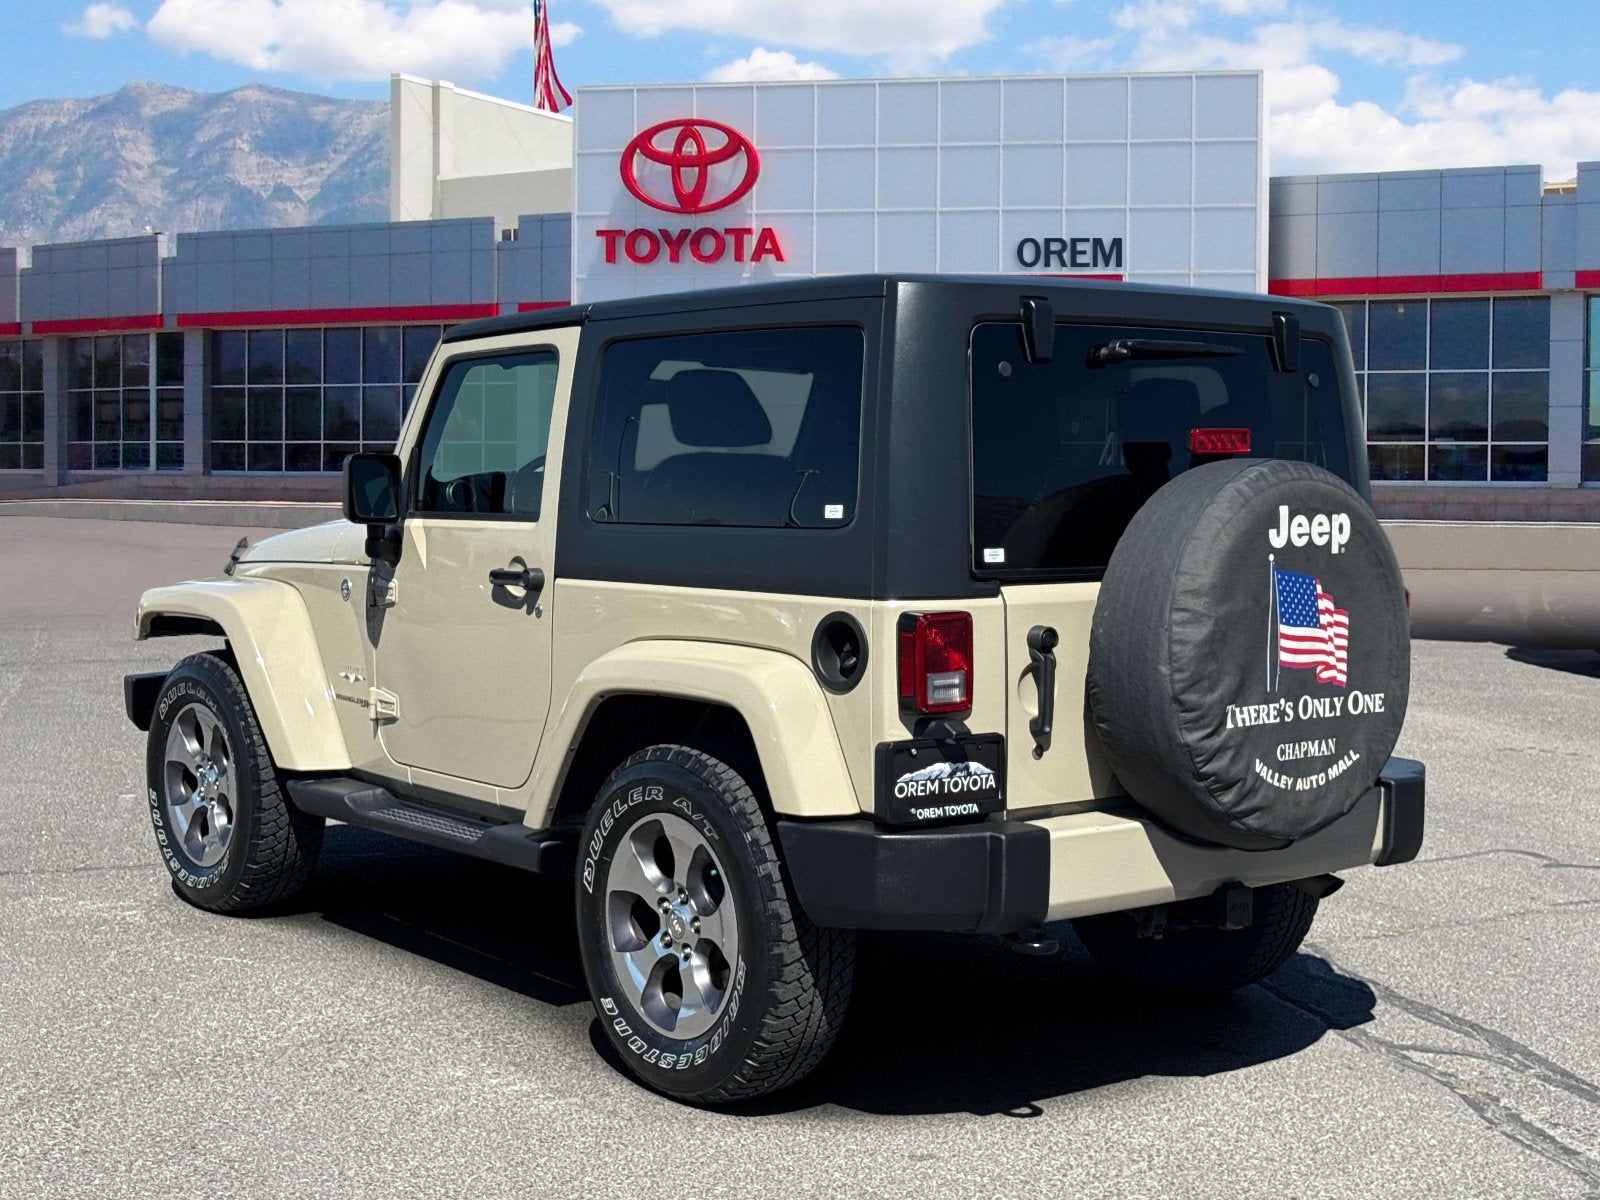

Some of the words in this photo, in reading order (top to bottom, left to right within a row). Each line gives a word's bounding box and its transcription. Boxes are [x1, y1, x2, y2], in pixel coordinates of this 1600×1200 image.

[595, 227, 785, 264] TOYOTA
[1016, 237, 1123, 268] OREM
[1268, 505, 1351, 554] Jeep
[1225, 697, 1294, 729] THERE'S
[1298, 695, 1344, 721] ONLY
[1347, 690, 1385, 715] ONE
[1276, 737, 1337, 762] CHAPMAN
[894, 779, 939, 799] OREM
[941, 774, 996, 794] TOYOTA
[1254, 758, 1294, 791] VALLEY
[1295, 772, 1326, 791] AUTO
[1327, 749, 1361, 781] MALL
[916, 807, 944, 820] OREM
[944, 803, 979, 816] TOYOTA
[583, 786, 664, 894] DUELER
[600, 954, 747, 1070] BRIDGESTONE
